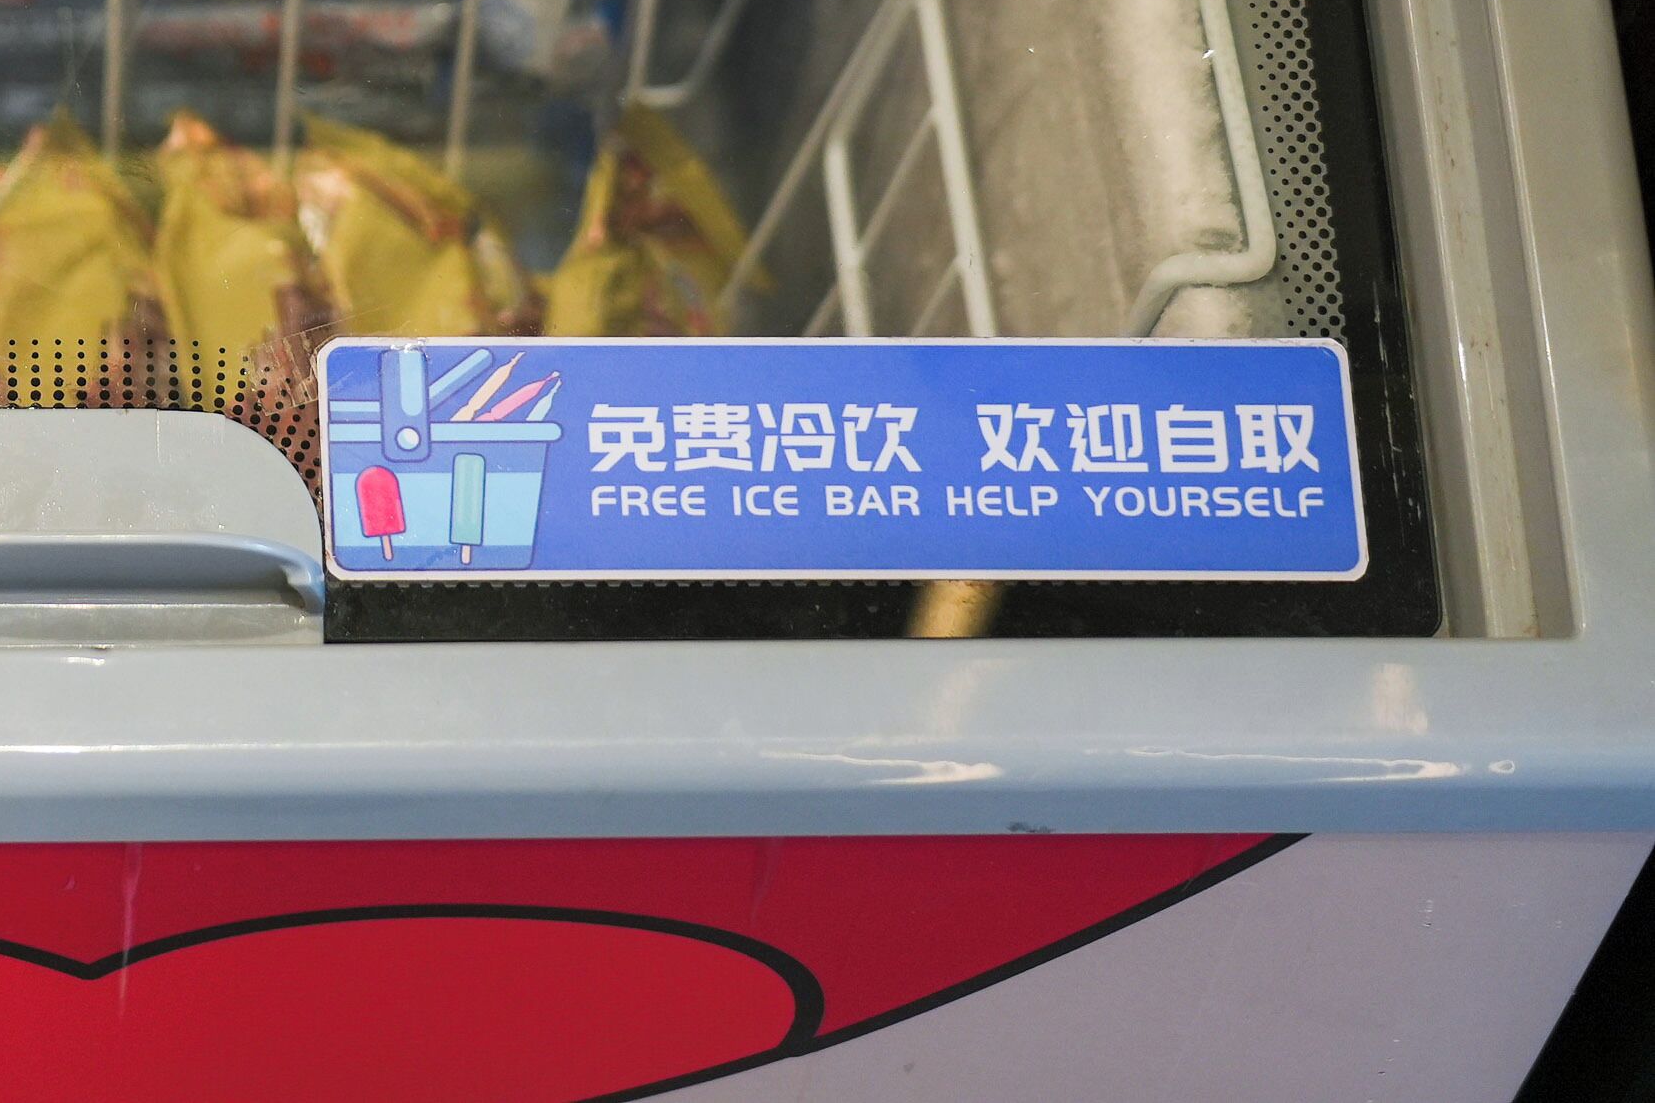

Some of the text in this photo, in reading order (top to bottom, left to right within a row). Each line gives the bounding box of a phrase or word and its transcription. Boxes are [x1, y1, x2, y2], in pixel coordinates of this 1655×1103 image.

[587, 402, 1322, 474] 免费冷饮 欢迎自取
[590, 484, 1325, 519] FREE ICE BAR HELP YOURSELF
